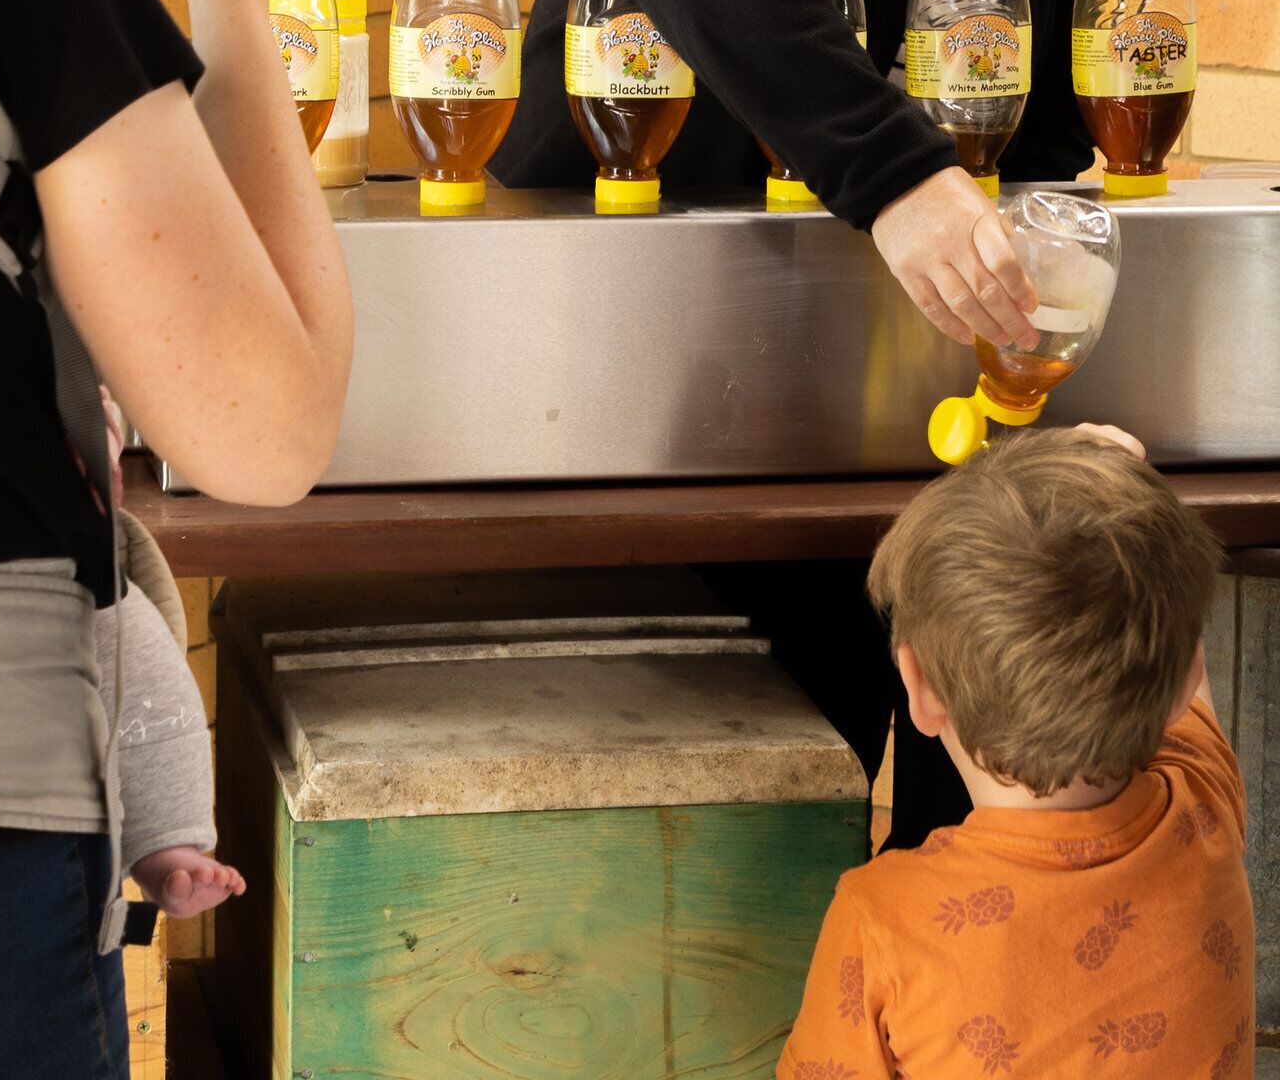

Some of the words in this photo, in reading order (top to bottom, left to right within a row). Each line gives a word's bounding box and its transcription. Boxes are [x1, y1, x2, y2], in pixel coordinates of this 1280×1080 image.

[448, 19, 472, 34] The
[625, 18, 649, 31] The
[971, 21, 992, 33] The
[1136, 18, 1158, 31] The
[280, 33, 317, 56] Place
[423, 31, 466, 52] Honey
[469, 31, 506, 55] Place
[600, 31, 644, 51] Honey
[945, 34, 988, 54] Honey
[992, 31, 1020, 51] Place
[1112, 32, 1153, 49] Honey
[1115, 44, 1187, 62] TASTER
[432, 87, 472, 98] Scribbly
[476, 87, 495, 97] Gum
[610, 83, 670, 95] Blackbutt
[948, 84, 976, 92] White
[981, 82, 1019, 92] Mahogany
[1134, 83, 1152, 91] Blue
